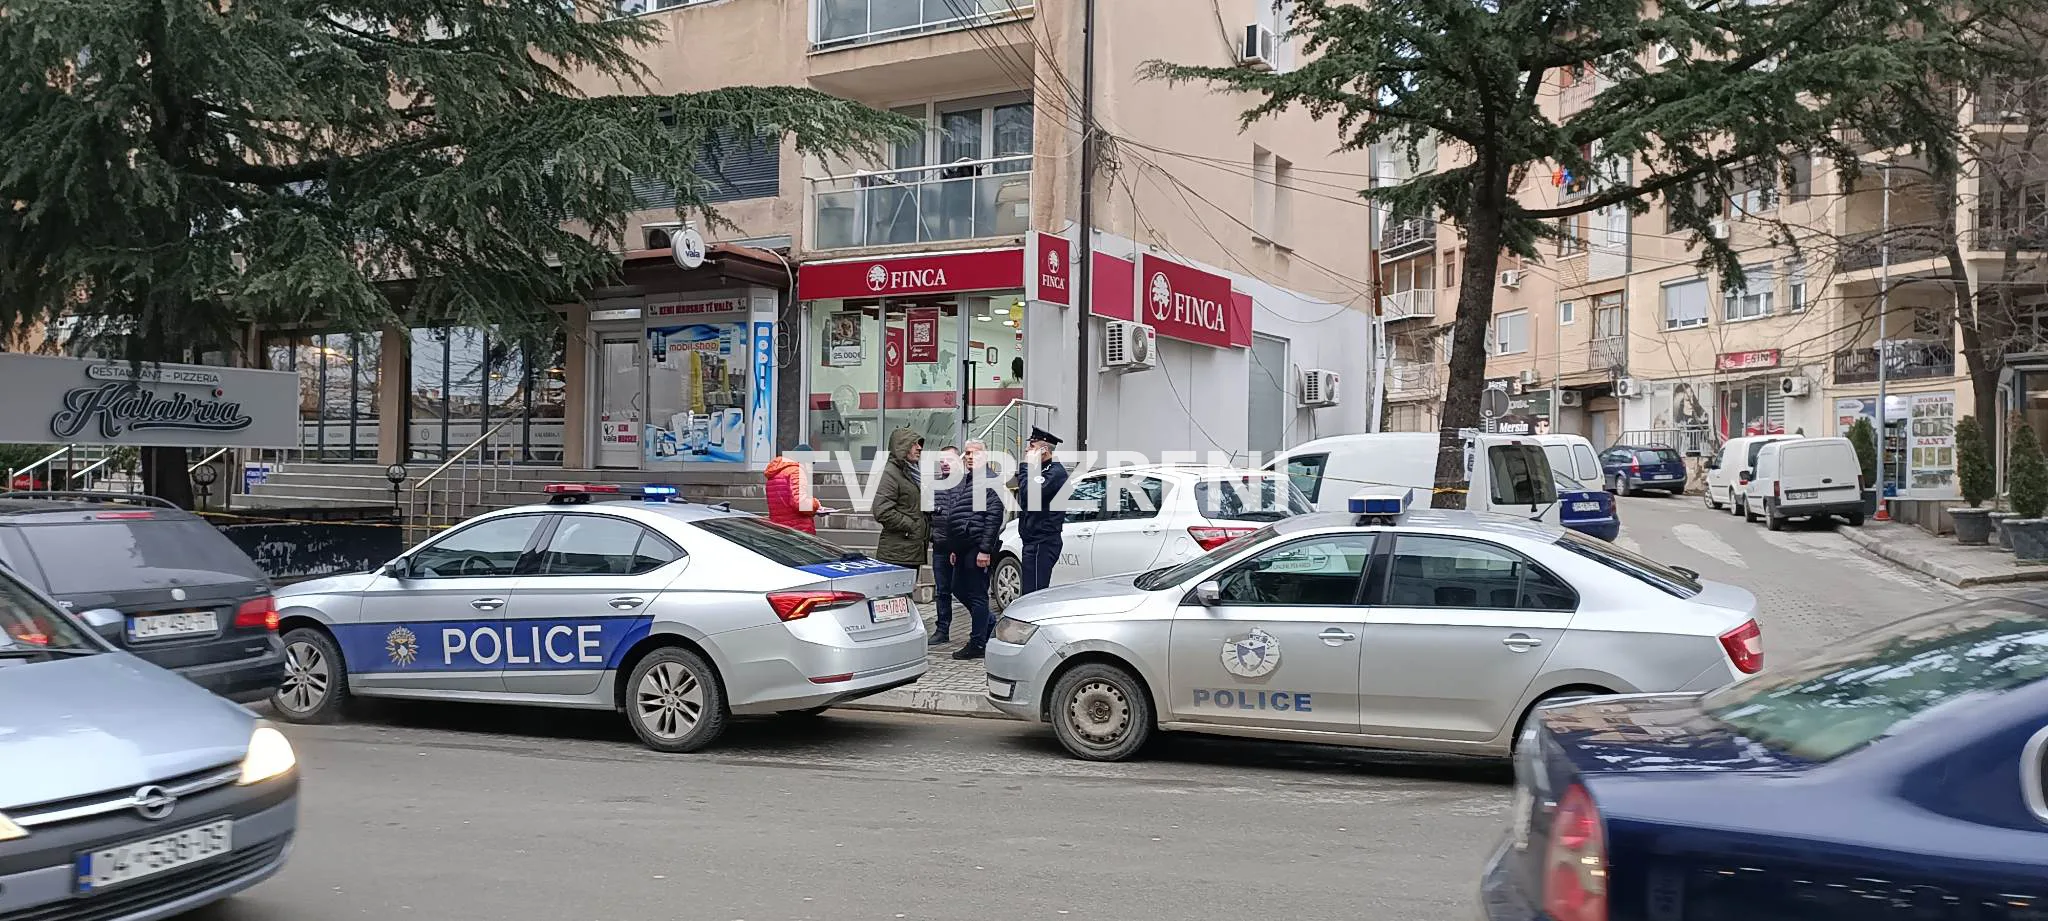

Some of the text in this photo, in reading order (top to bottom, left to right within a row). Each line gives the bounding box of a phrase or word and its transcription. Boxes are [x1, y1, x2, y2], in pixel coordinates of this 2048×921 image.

[685, 248, 701, 258] vala
[890, 268, 947, 289] FINCA
[1042, 273, 1065, 290] FINCA
[1174, 292, 1226, 332] FINCA
[92, 366, 162, 381] RESTAUANT
[173, 371, 219, 383] PIZZERIA
[51, 381, 253, 439] Kalabria
[822, 419, 869, 435] FINCA
[1499, 420, 1529, 433] Mersin
[603, 434, 617, 442] vala
[442, 624, 603, 665] POLICE
[1193, 689, 1313, 712] POLICE
